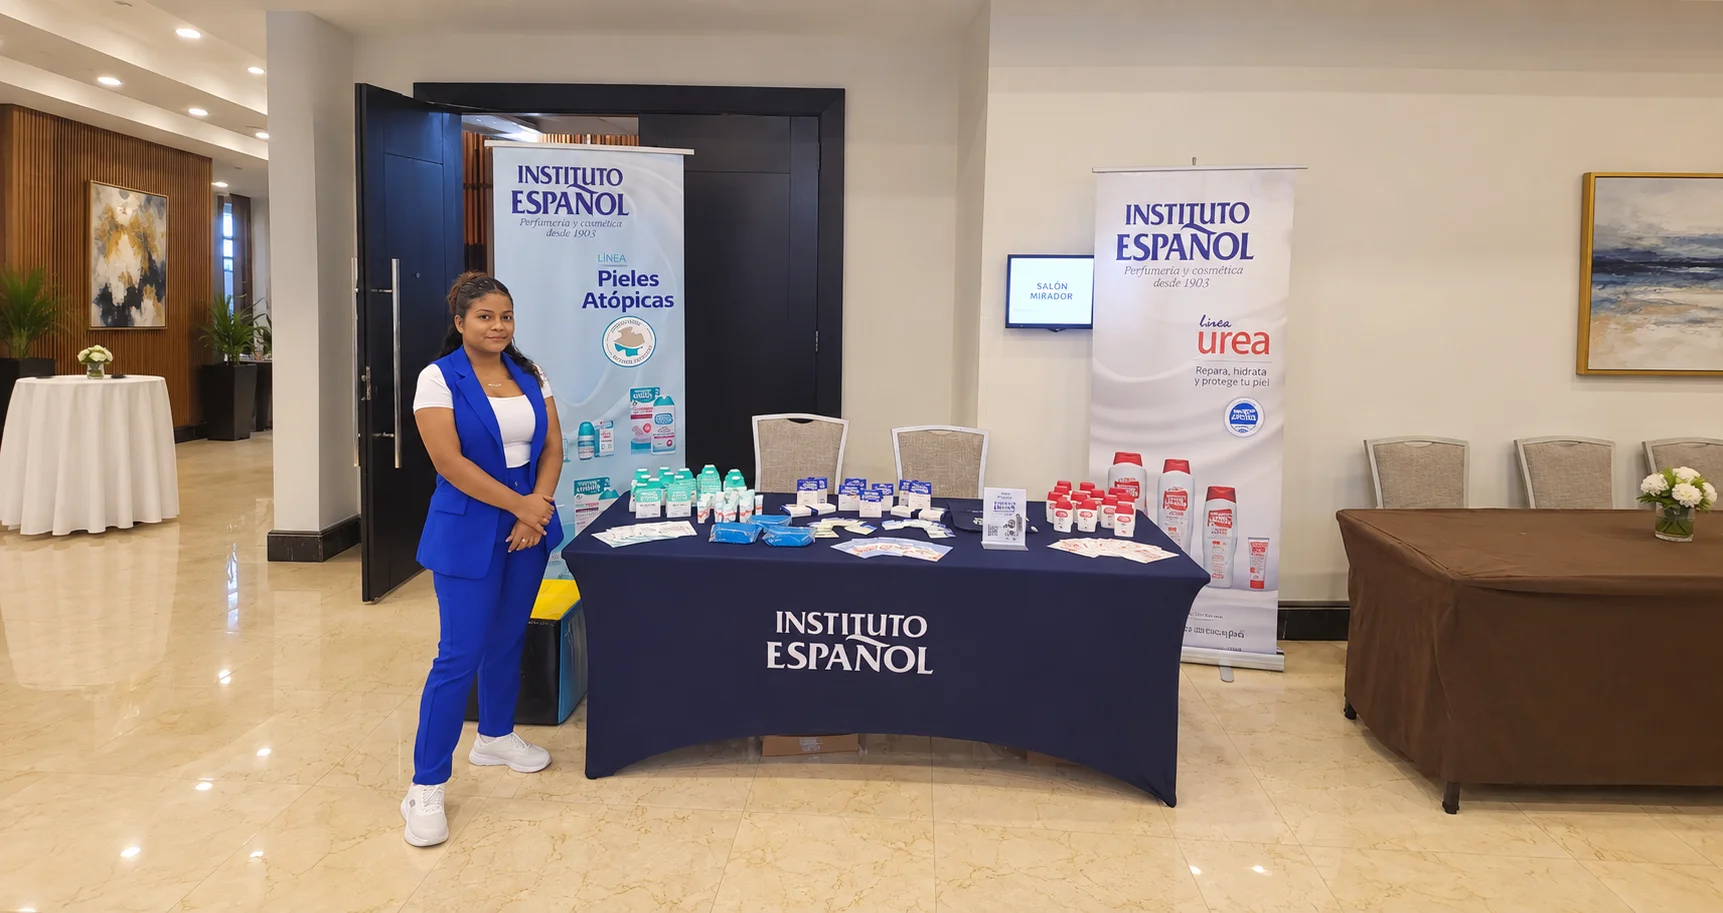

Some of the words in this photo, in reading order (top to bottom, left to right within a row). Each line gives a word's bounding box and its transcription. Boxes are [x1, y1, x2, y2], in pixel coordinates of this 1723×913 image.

[517, 165, 623, 187] INSTITUTO
[511, 185, 629, 216] ESPAÑOL
[1125, 201, 1250, 226] INSTITUTO
[573, 220, 579, 228] y
[546, 228, 571, 237] desde
[574, 229, 597, 238] 1903
[1116, 224, 1254, 262] ESPAÑOL
[597, 252, 627, 263] LÍNEA
[598, 269, 660, 287] Pieles
[1182, 269, 1189, 277] y
[1192, 265, 1244, 275] cosmética
[1036, 280, 1068, 290] SALÓN
[1153, 277, 1181, 288] desde
[1184, 278, 1210, 288] 1903
[582, 290, 675, 313] Atópicas
[1029, 291, 1073, 300] MIRADOR
[1198, 331, 1270, 355] urea
[1195, 366, 1231, 377] Repara,
[1233, 367, 1268, 377] hidrata
[1194, 378, 1200, 387] y
[1201, 377, 1239, 388] protege
[1240, 379, 1250, 387] tu
[1252, 377, 1270, 388] piel
[775, 610, 928, 638] INSTITUTO
[766, 634, 934, 675] ESPAÑOL
